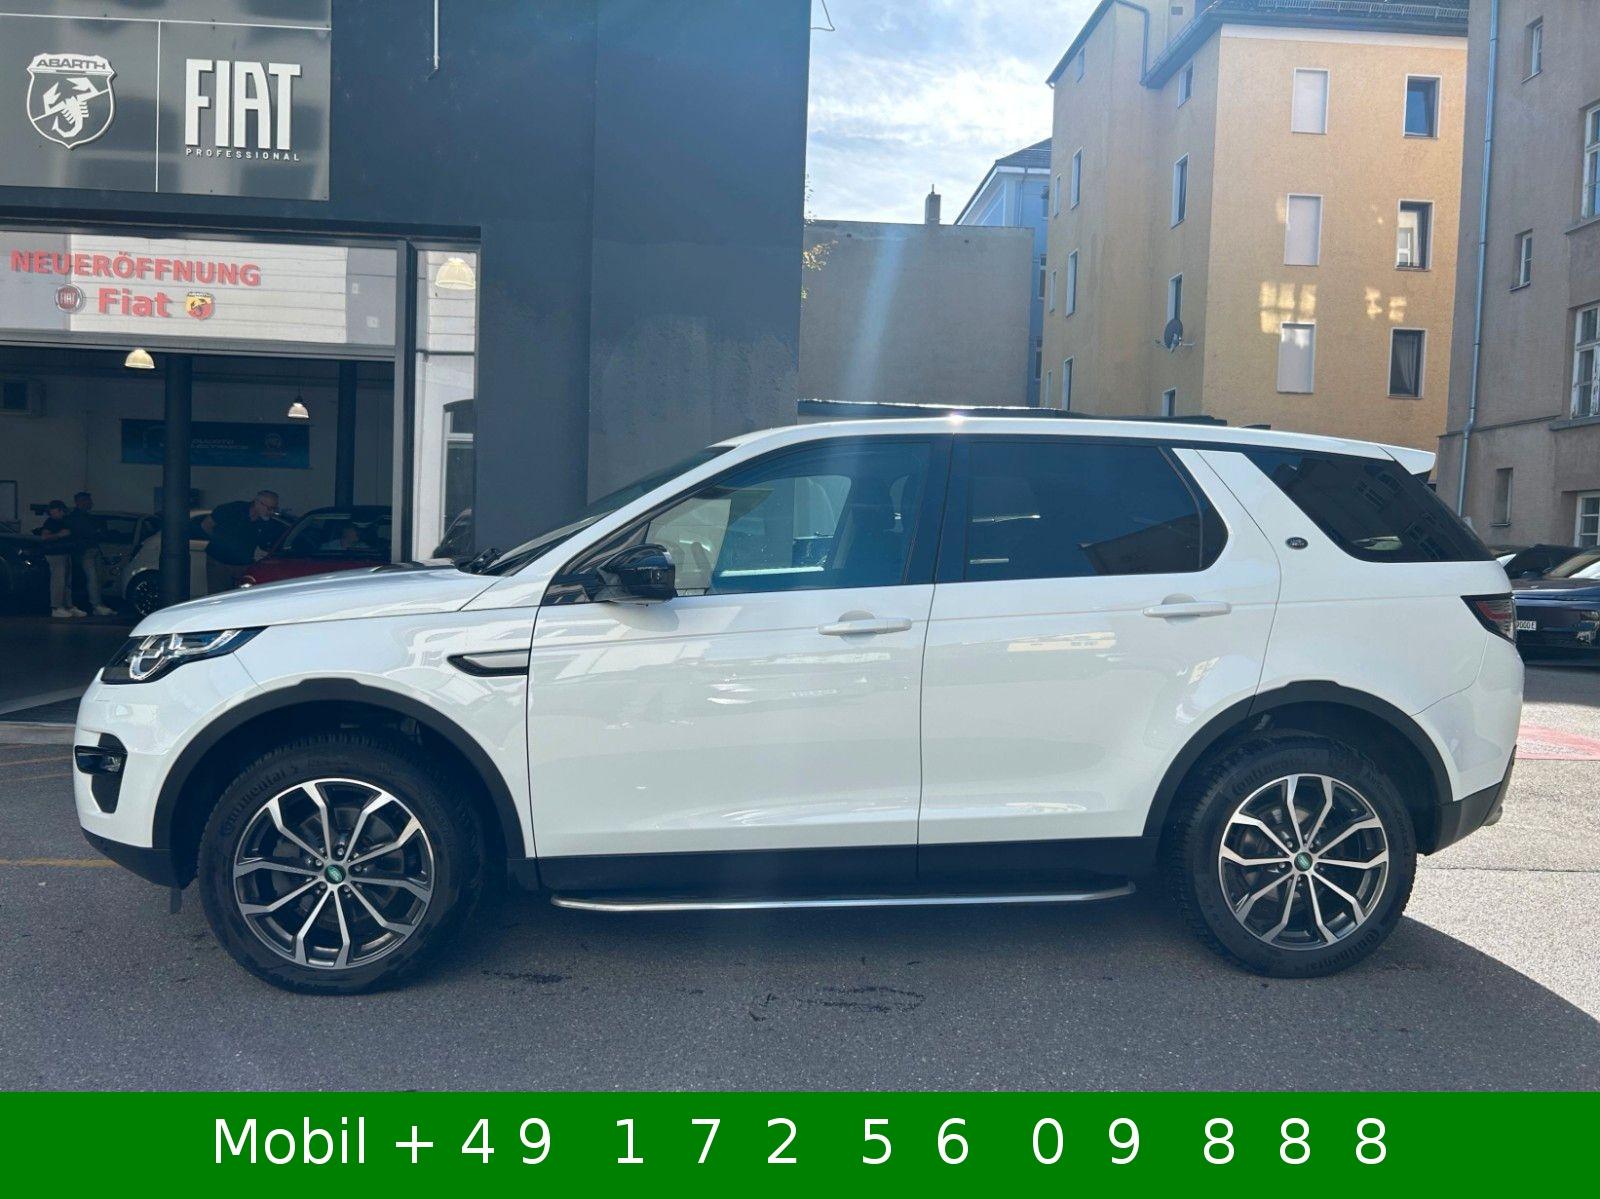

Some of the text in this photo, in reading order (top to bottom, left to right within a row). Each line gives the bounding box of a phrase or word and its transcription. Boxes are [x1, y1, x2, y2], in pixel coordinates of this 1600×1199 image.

[36, 58, 106, 70] ABARTH
[184, 58, 301, 150] FIAT
[185, 147, 300, 161] PROFESSIONAL
[10, 249, 262, 286] NEUERÖFFNUNG
[97, 287, 170, 318] Fiat
